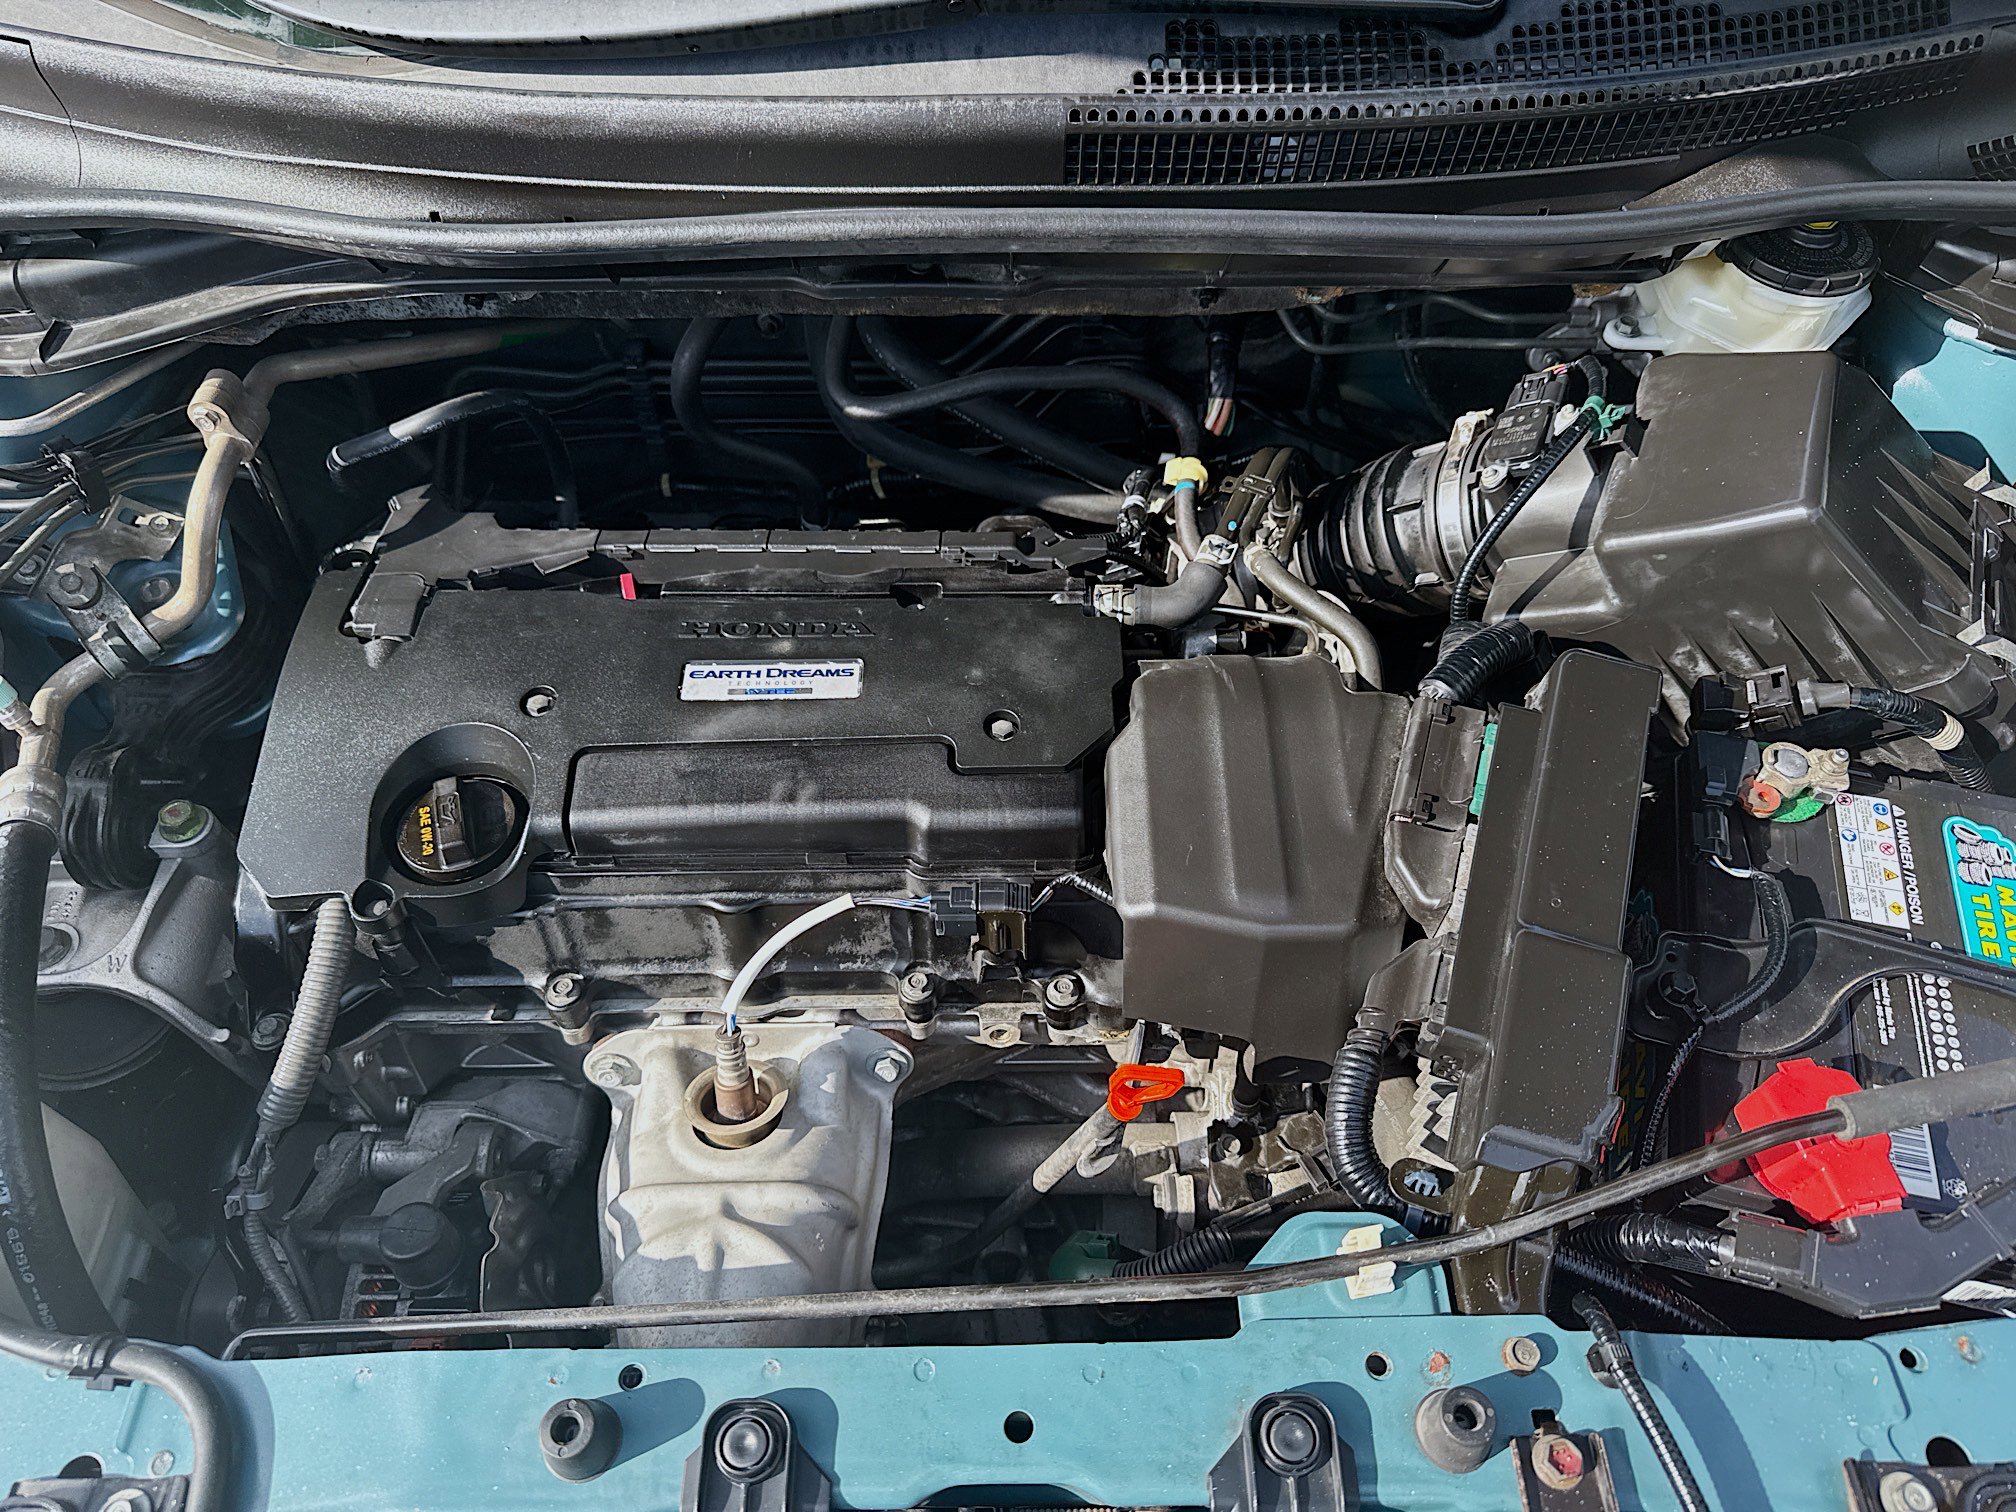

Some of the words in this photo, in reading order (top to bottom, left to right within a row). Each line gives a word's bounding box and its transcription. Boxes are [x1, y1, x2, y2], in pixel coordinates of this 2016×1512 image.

[678, 621, 876, 638] HONDA
[689, 669, 761, 679] EARTH
[766, 668, 855, 678] DREAMS
[419, 806, 431, 827] SAE
[421, 827, 434, 856] 0W-20
[1895, 818, 1914, 870] DANGER
[1971, 893, 2002, 958] TIRE
[1996, 884, 2016, 967] MAV
